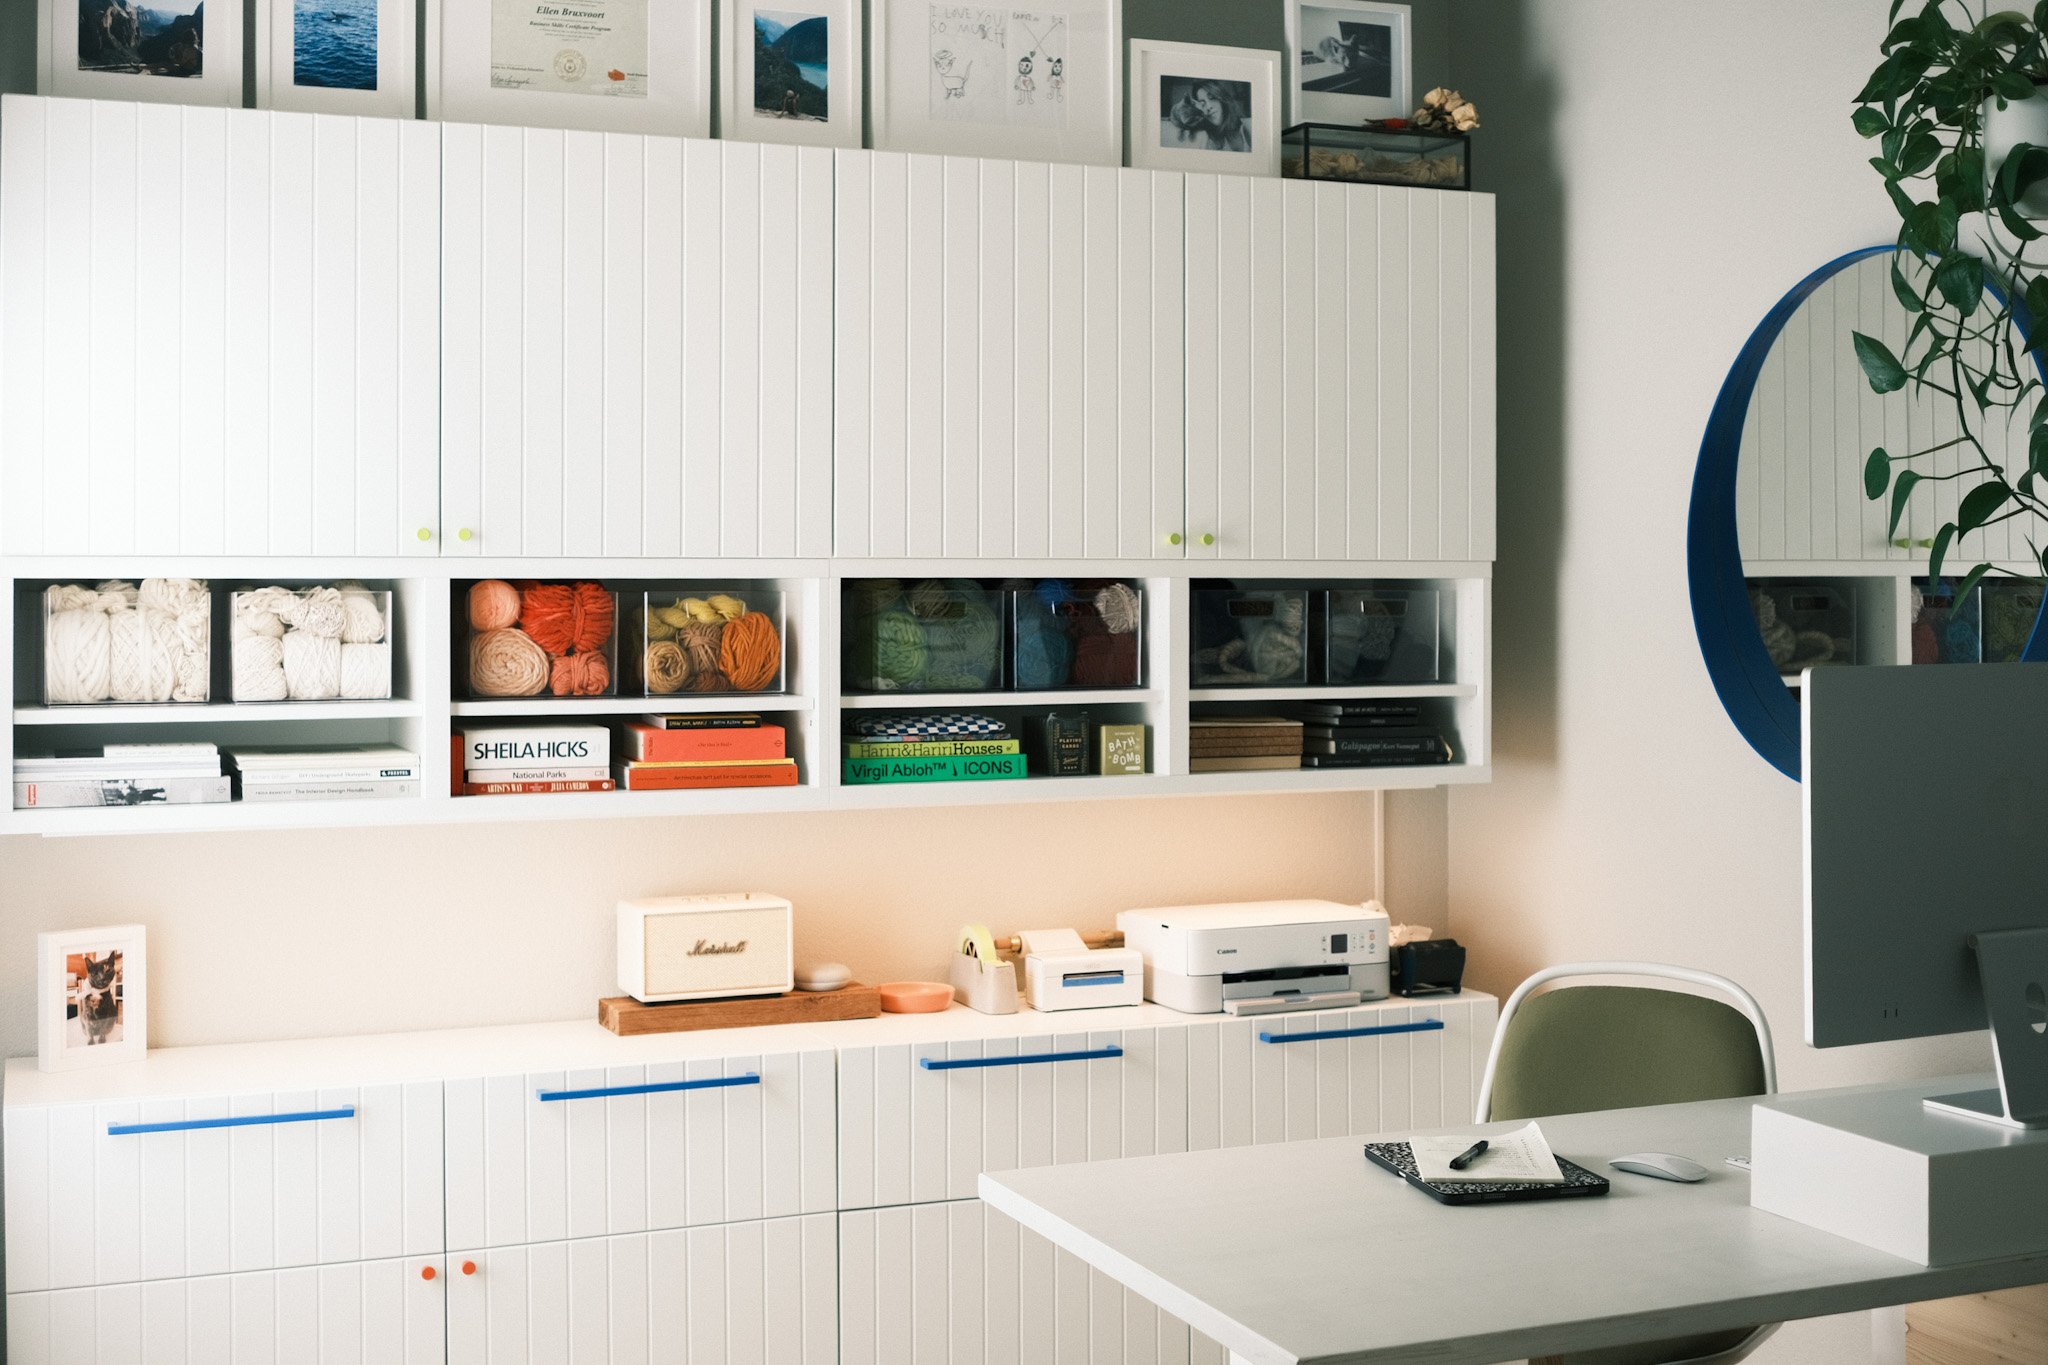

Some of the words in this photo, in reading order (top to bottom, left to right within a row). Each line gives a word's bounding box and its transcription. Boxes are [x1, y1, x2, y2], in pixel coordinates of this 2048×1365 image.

[536, 6, 559, 15] Ellen
[561, 8, 605, 18] Bruxvoort
[945, 7, 972, 19] LOVE
[976, 8, 1002, 27] YOU
[930, 20, 947, 35] SO
[474, 742, 535, 760] SHEILA
[537, 741, 588, 758] HICKS
[1108, 736, 1136, 752] BATH
[1112, 752, 1141, 765] BOMB
[512, 770, 545, 779] National
[546, 770, 567, 778] Parks
[851, 762, 889, 781] Virgil
[963, 761, 1013, 775] ICONS
[511, 783, 523, 792] WAY
[551, 782, 565, 792] JULIA
[566, 781, 590, 791] CAMERON
[687, 939, 747, 957] Marshall
